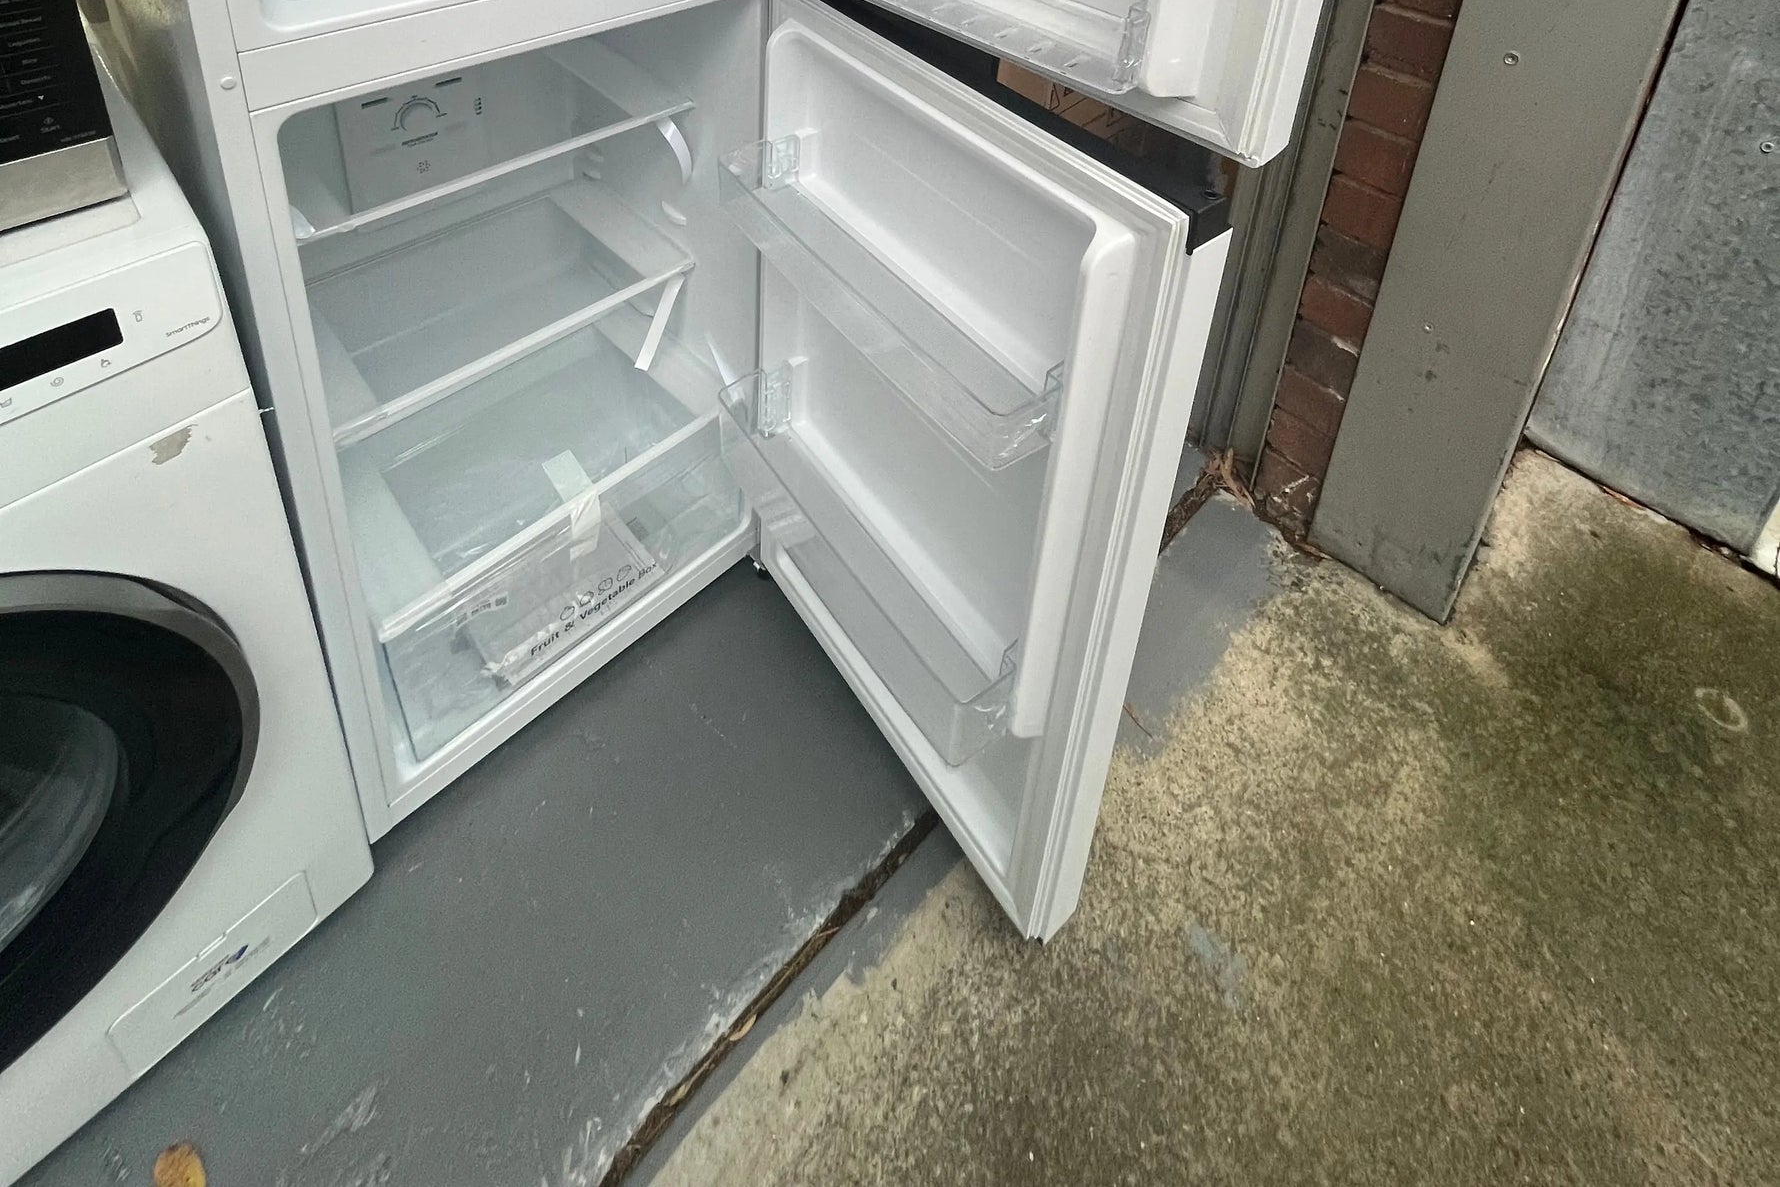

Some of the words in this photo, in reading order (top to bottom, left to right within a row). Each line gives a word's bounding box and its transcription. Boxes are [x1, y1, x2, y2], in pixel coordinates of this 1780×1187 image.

[166, 316, 210, 337] SmartThings
[530, 631, 560, 656] Fruit
[564, 620, 576, 632] &
[579, 578, 636, 620] Vegetable
[638, 562, 658, 580] Box
